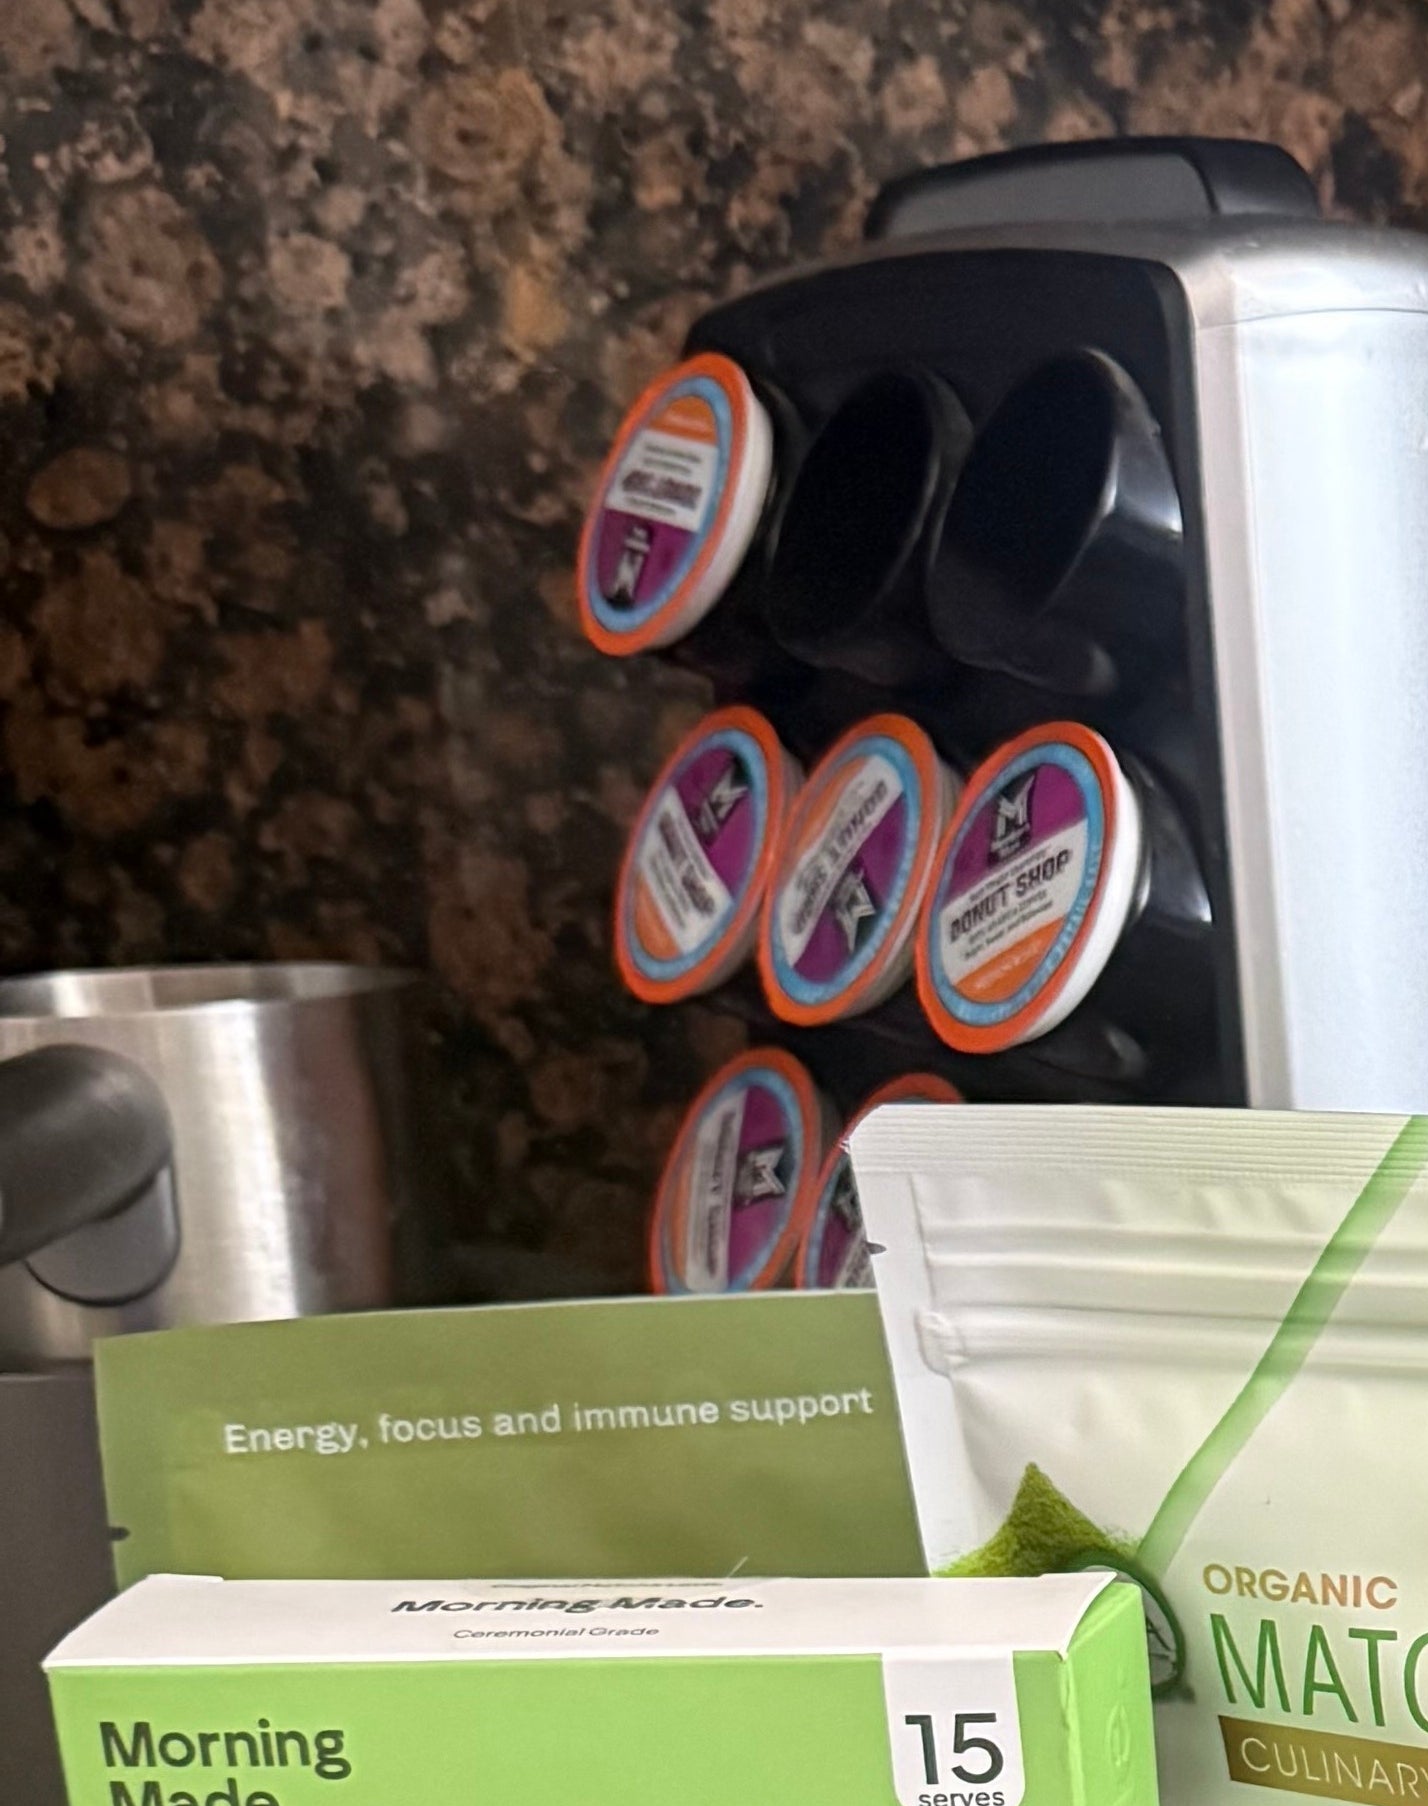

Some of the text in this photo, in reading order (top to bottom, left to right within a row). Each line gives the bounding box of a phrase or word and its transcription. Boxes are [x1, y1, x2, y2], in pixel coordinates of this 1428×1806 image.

[949, 882, 1013, 944] DONUT
[1015, 849, 1072, 898] SHOP
[225, 1388, 873, 1454] Energy, focus and immune support
[391, 1596, 763, 1614] Morning Made.
[1202, 1563, 1398, 1609] ORGANIC
[453, 1627, 659, 1640] Ceremonial Grade
[100, 1718, 352, 1780] Morning
[904, 1712, 1005, 1785] 15
